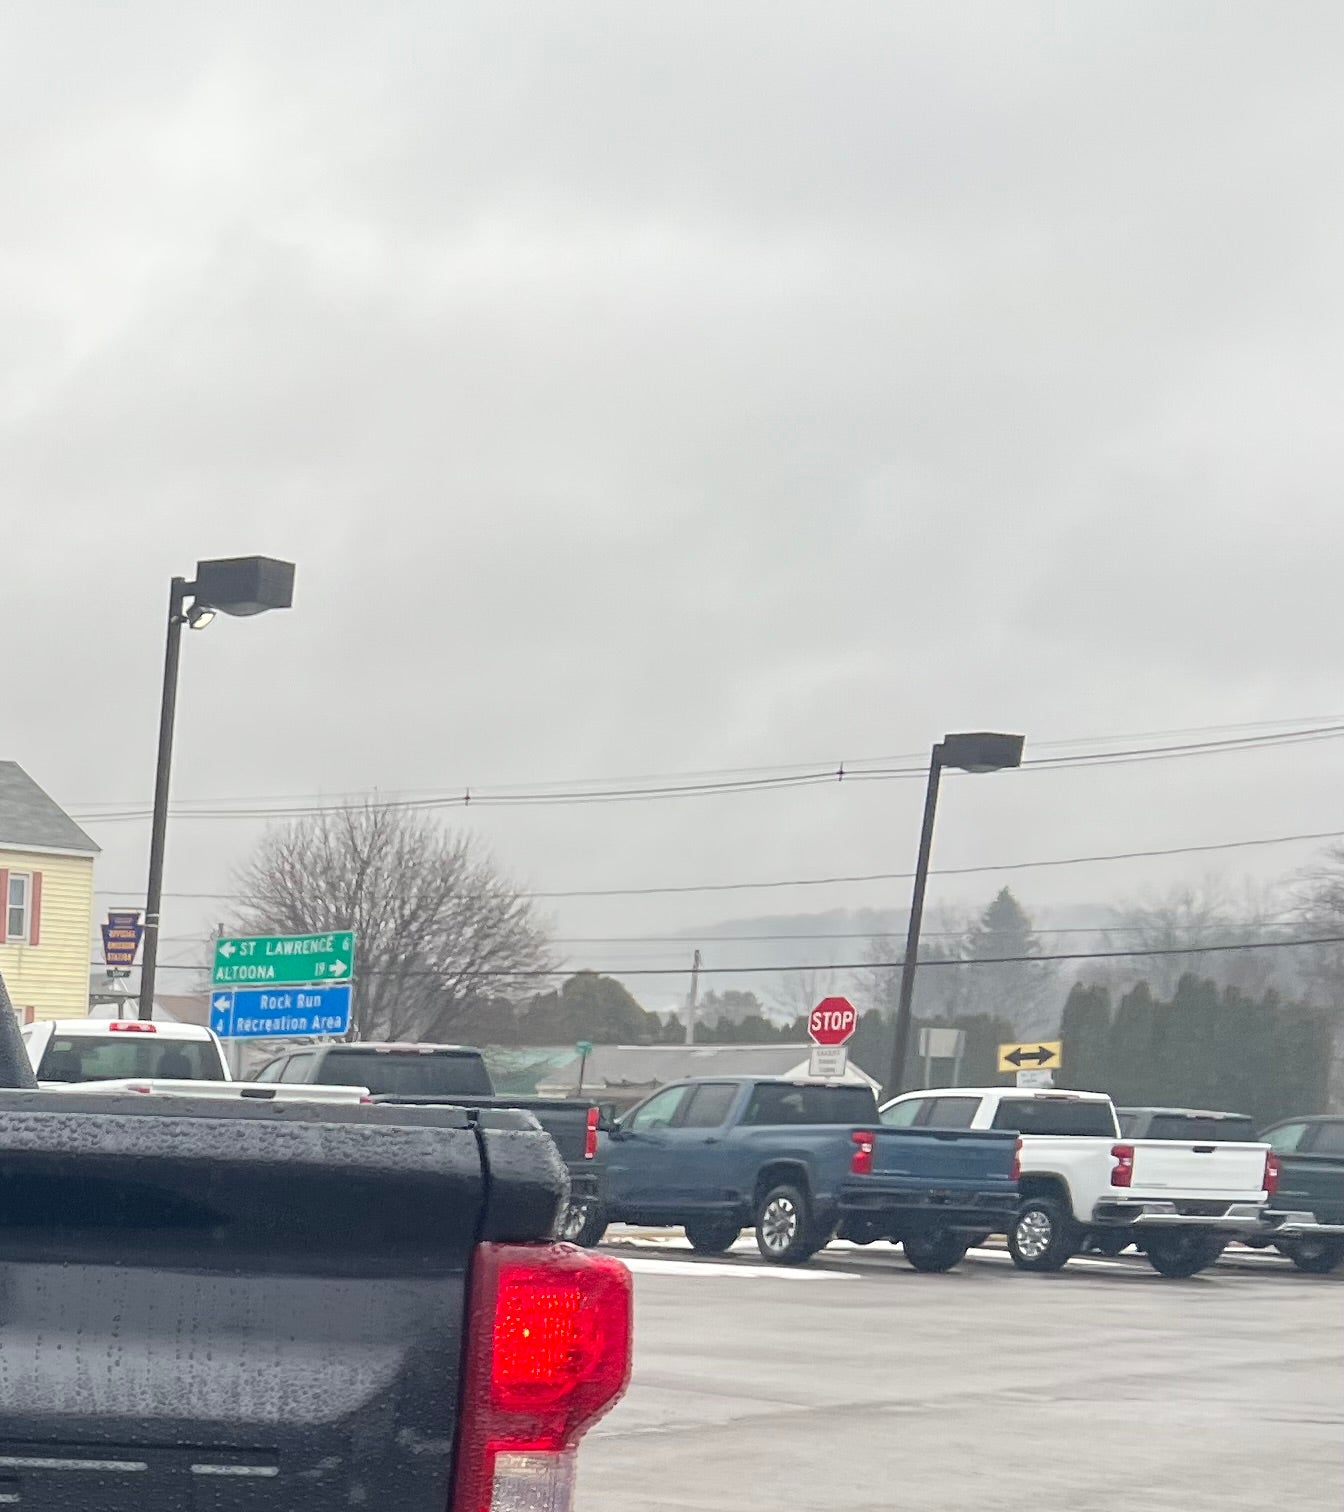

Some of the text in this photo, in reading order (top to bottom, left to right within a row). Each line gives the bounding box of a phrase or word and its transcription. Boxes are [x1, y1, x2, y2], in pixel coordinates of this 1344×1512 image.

[239, 941, 256, 956] ST
[265, 936, 334, 955] LAWRENCE
[215, 962, 326, 980] ALTOONA 19
[260, 993, 321, 1010] Rock Run
[236, 1014, 342, 1032] Recreation Area
[811, 1011, 853, 1031] STOP
